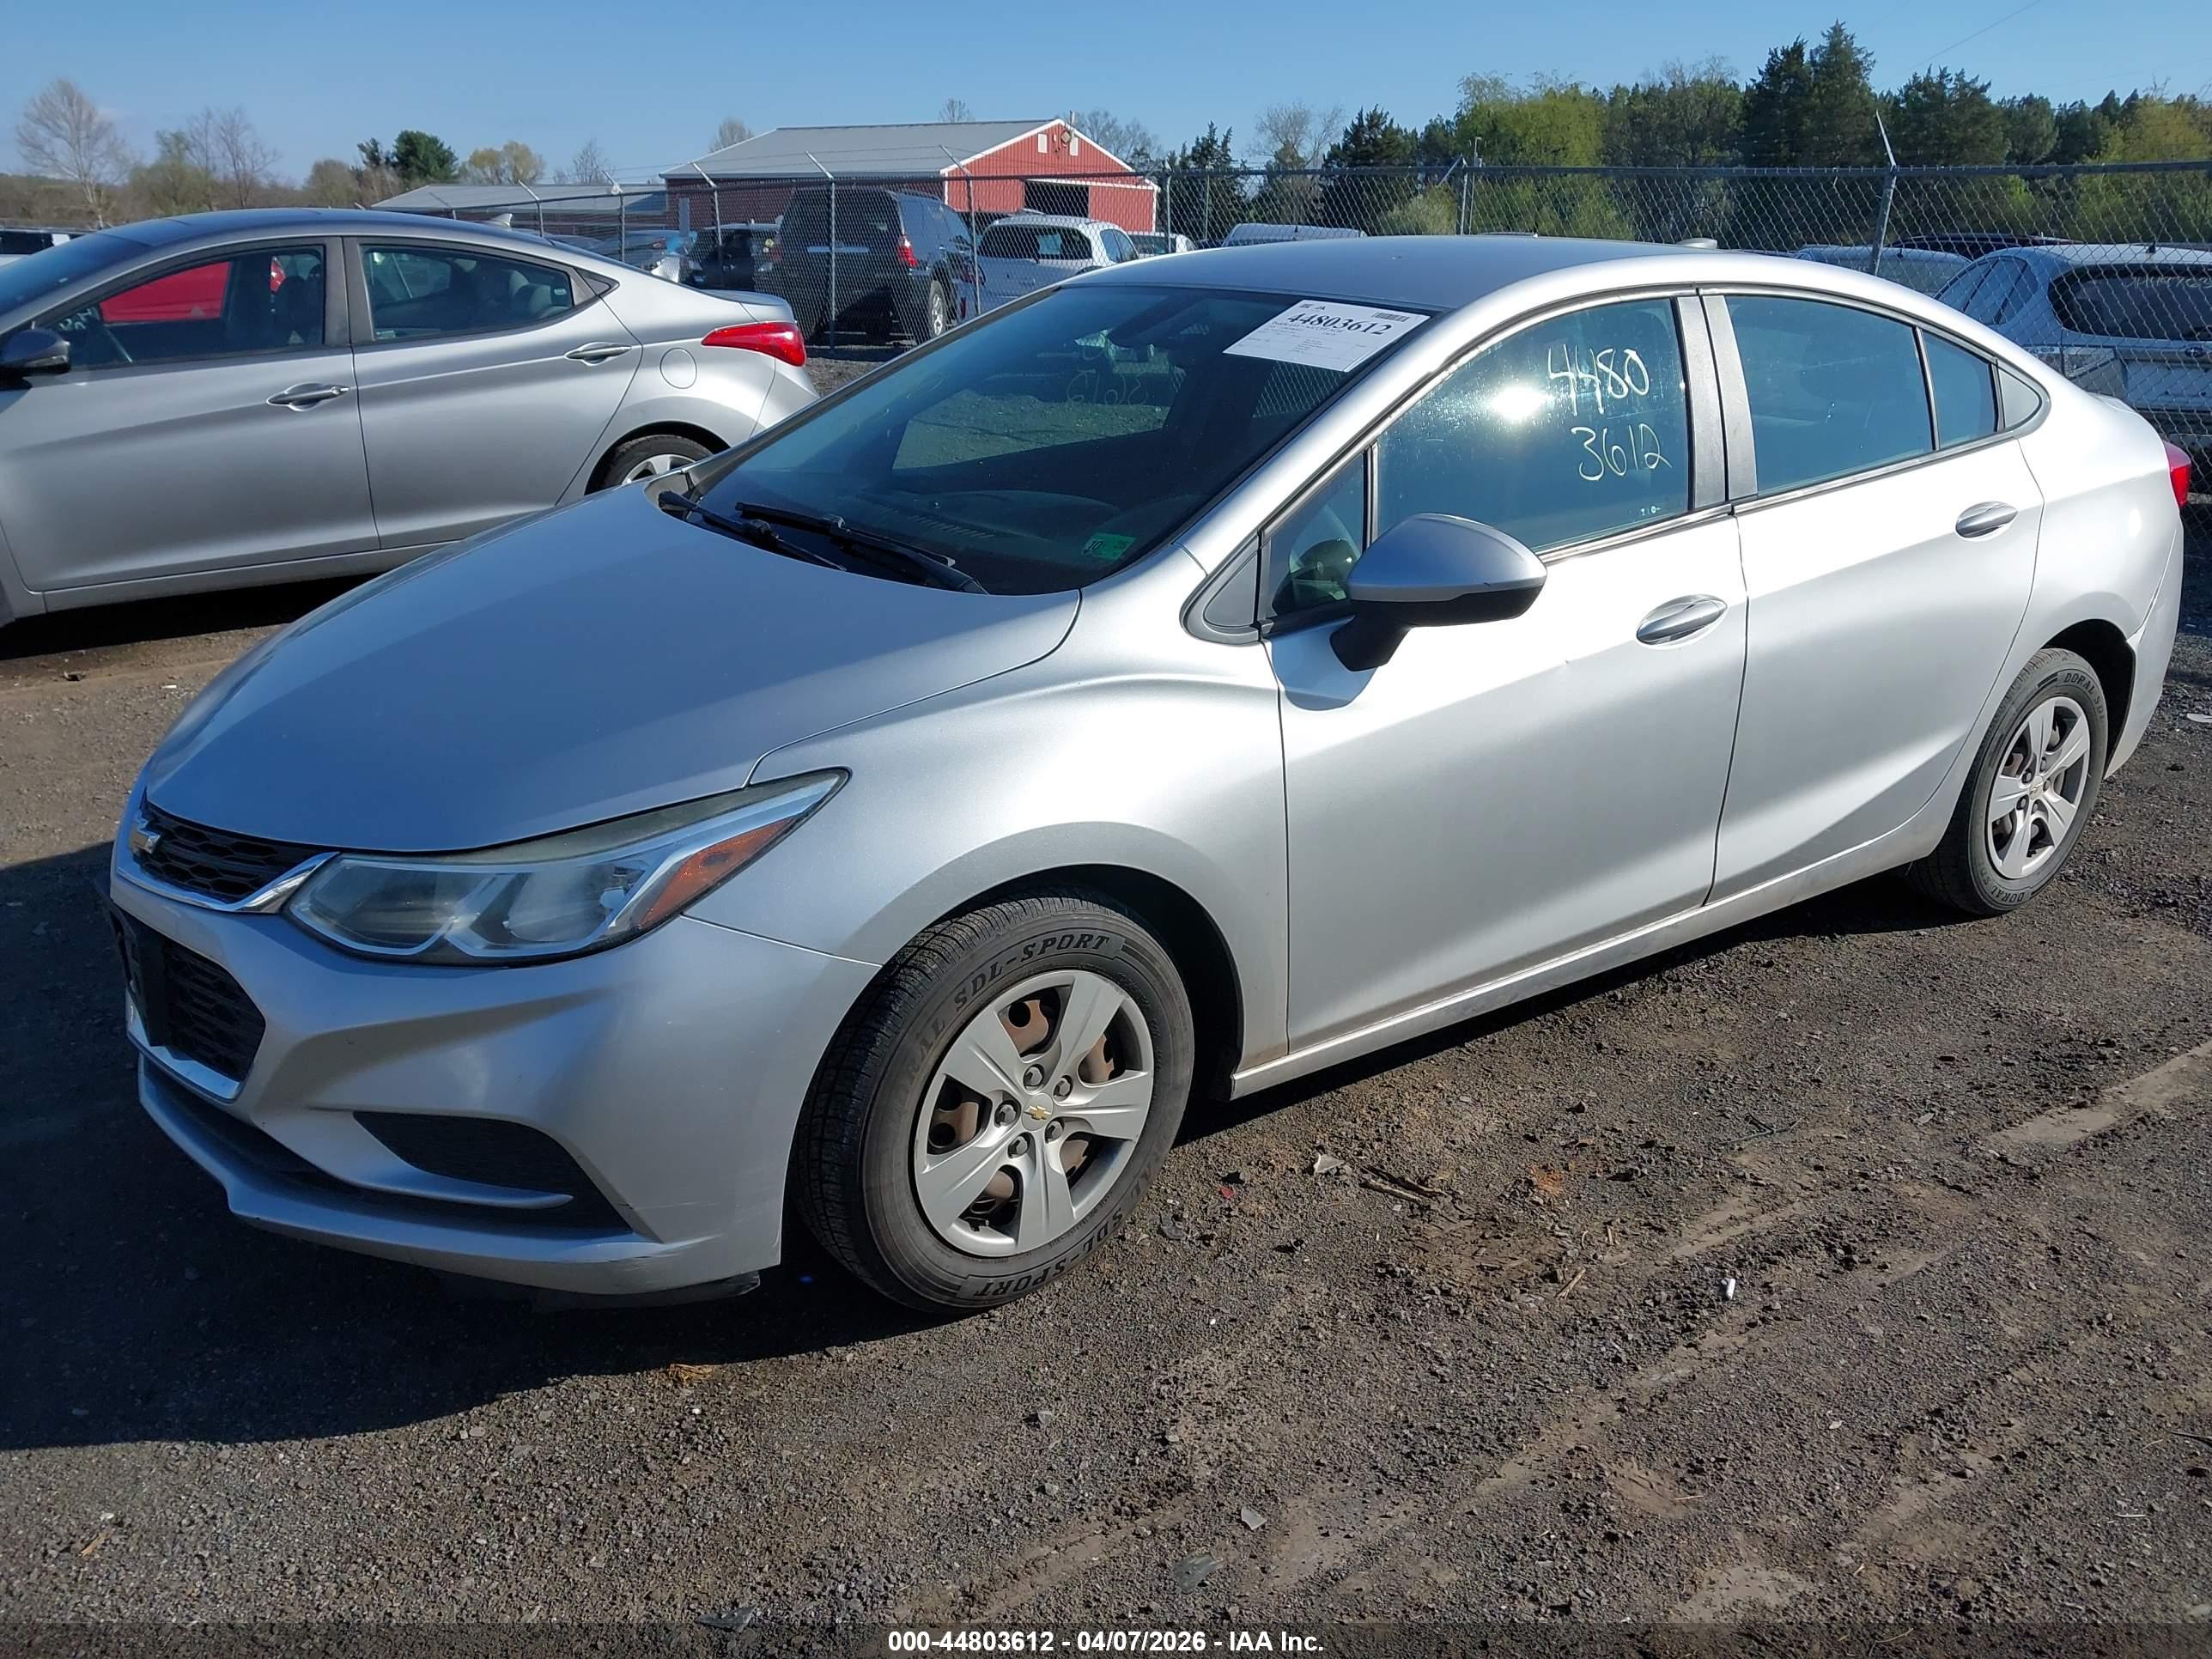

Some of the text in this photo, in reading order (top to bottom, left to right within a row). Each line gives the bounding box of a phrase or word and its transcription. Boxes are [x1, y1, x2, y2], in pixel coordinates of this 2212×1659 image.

[1287, 313, 1392, 335] 44803612
[1547, 343, 1650, 416] 4480
[1571, 423, 1673, 481] 3612
[2063, 672, 2095, 695] DORAL
[1990, 885, 2025, 902] DORAL
[953, 933, 1110, 1012] SDL-SPORT
[973, 1206, 1123, 1297] SDL-SPORT
